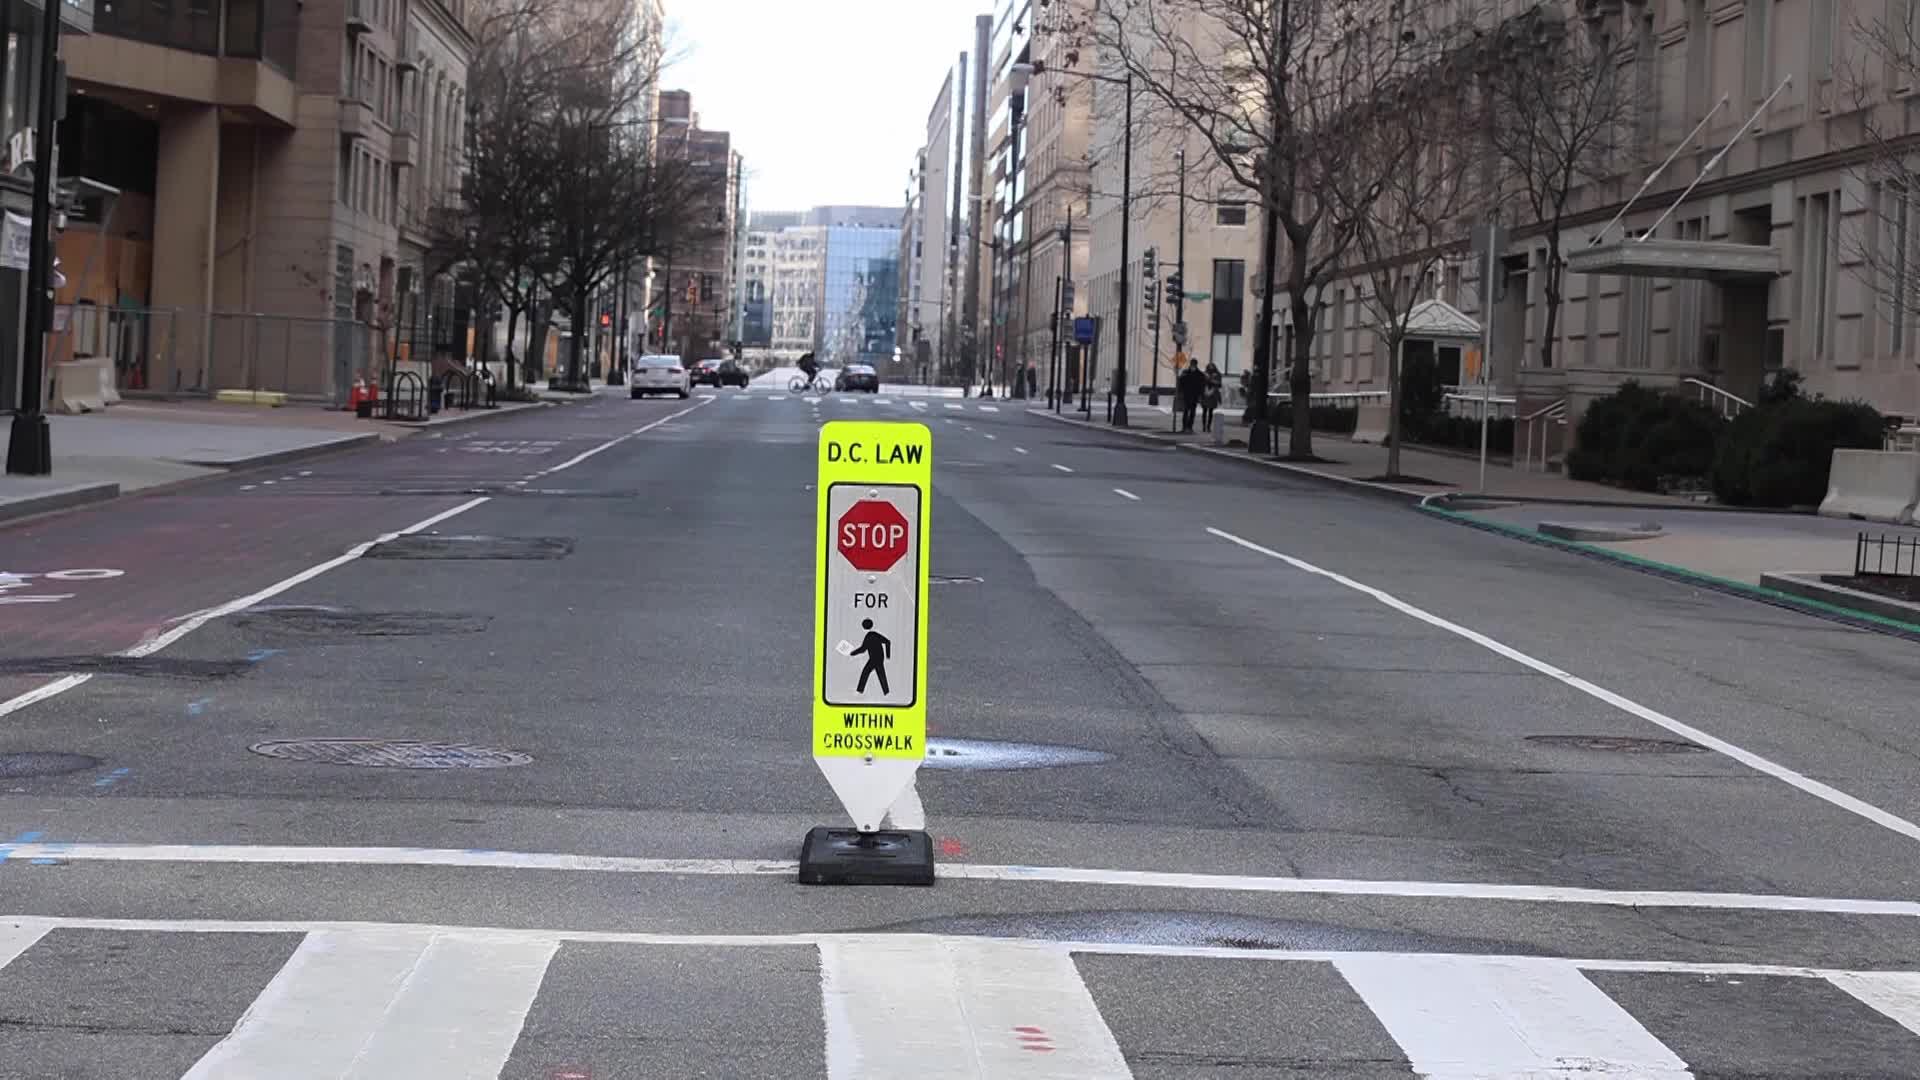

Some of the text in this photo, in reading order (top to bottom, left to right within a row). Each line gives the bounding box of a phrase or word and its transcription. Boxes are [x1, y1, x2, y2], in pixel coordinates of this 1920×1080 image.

[828, 442, 923, 464] D.C. LAW
[842, 523, 904, 549] STOP
[854, 593, 889, 608] FOR
[843, 713, 894, 729] WITHIN
[824, 733, 912, 750] CROSSWALK
